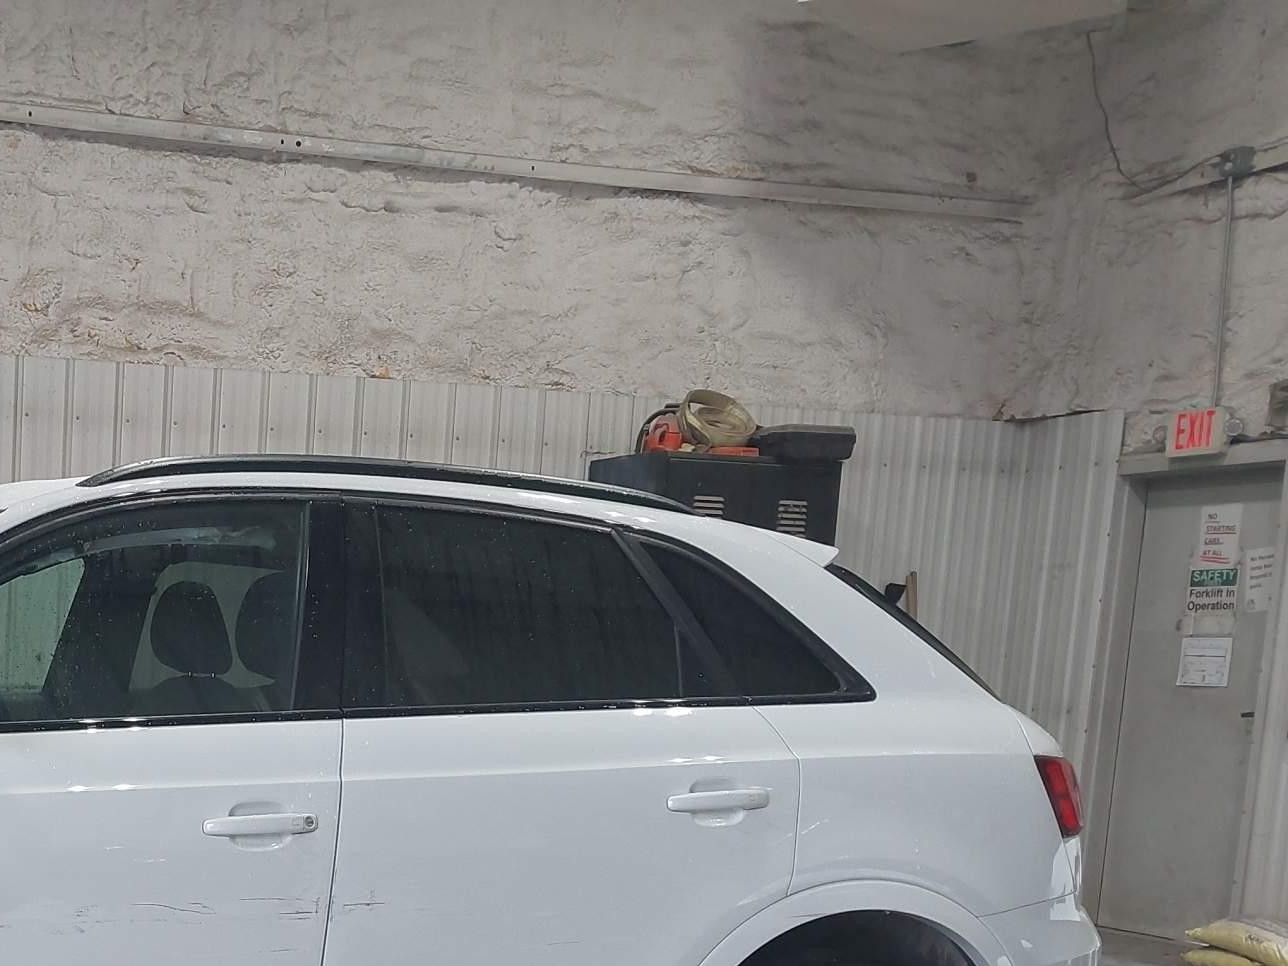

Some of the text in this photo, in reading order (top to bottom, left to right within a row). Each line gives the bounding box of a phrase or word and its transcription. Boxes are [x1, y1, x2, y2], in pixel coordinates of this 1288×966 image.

[1175, 411, 1216, 449] EXIT
[1193, 570, 1235, 581] SAFETY
[1190, 588, 1235, 598] Forklift In
[1187, 600, 1235, 613] Operation
